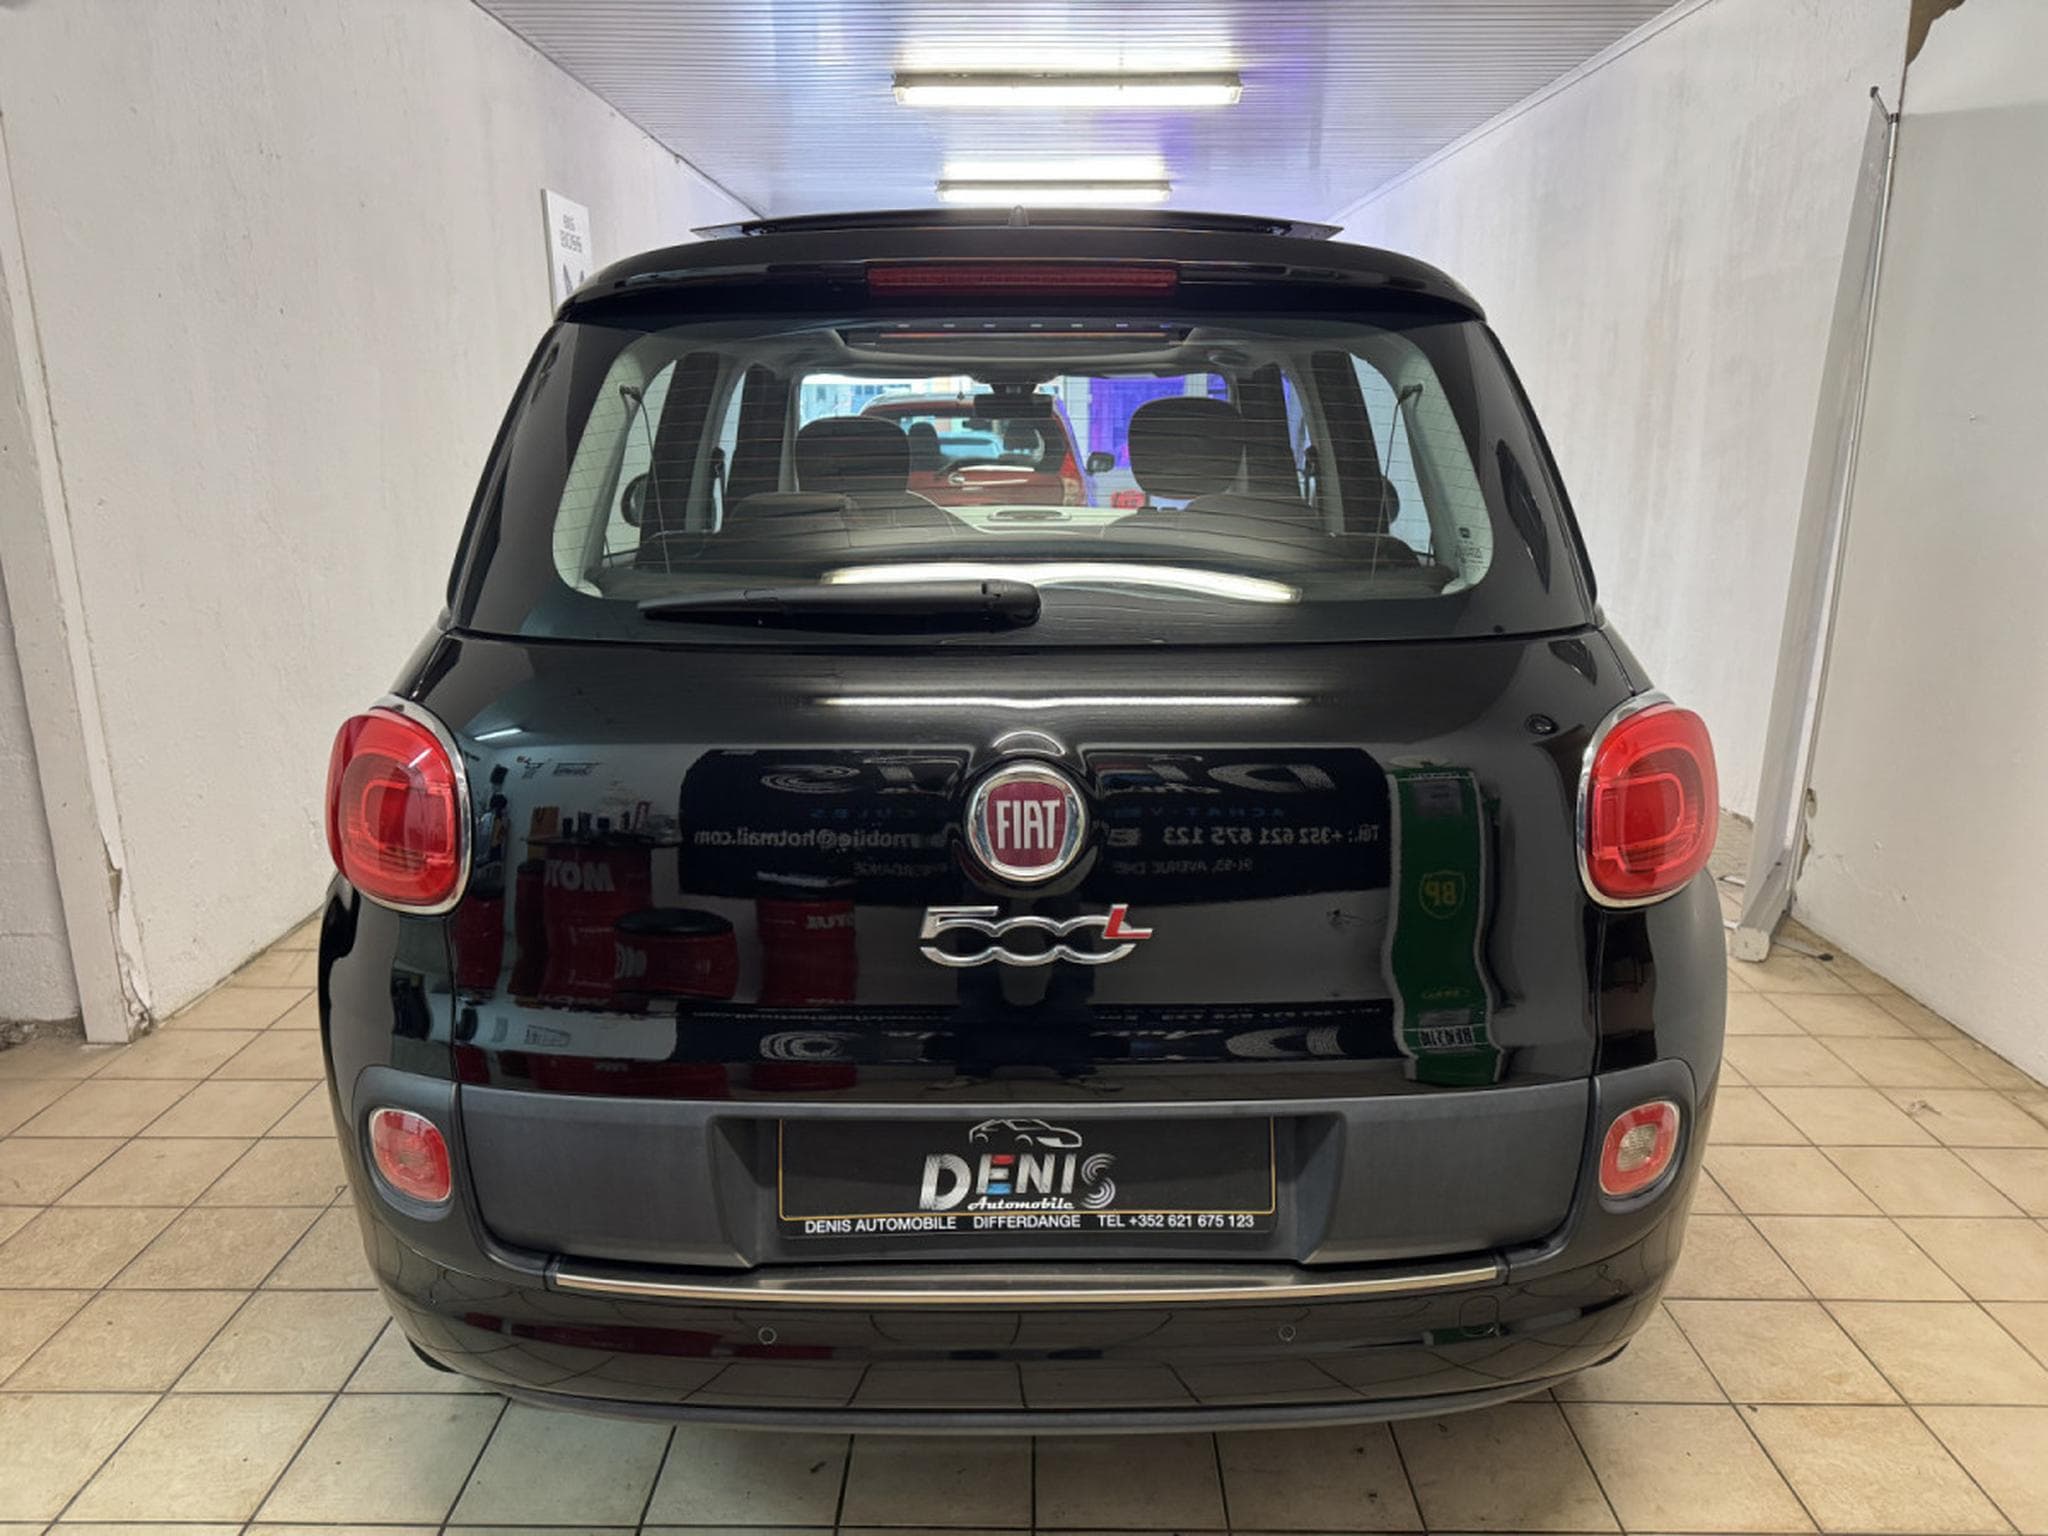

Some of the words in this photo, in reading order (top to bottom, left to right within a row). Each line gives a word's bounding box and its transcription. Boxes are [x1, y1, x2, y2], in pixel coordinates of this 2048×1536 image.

[995, 799, 1061, 850] FIAT
[920, 903, 1153, 967] 500L
[918, 1152, 1117, 1211] DENIS
[967, 1196, 1075, 1211] Automobile
[804, 1219, 852, 1234] DENIS
[854, 1215, 957, 1232] AUTOMOBILE
[973, 1214, 1081, 1229] DIFFERDANGE
[1098, 1214, 1126, 1228] TEL
[1128, 1214, 1165, 1228] +352
[1167, 1214, 1194, 1228] 621
[1197, 1214, 1225, 1228] 675
[1228, 1214, 1255, 1228] 123
